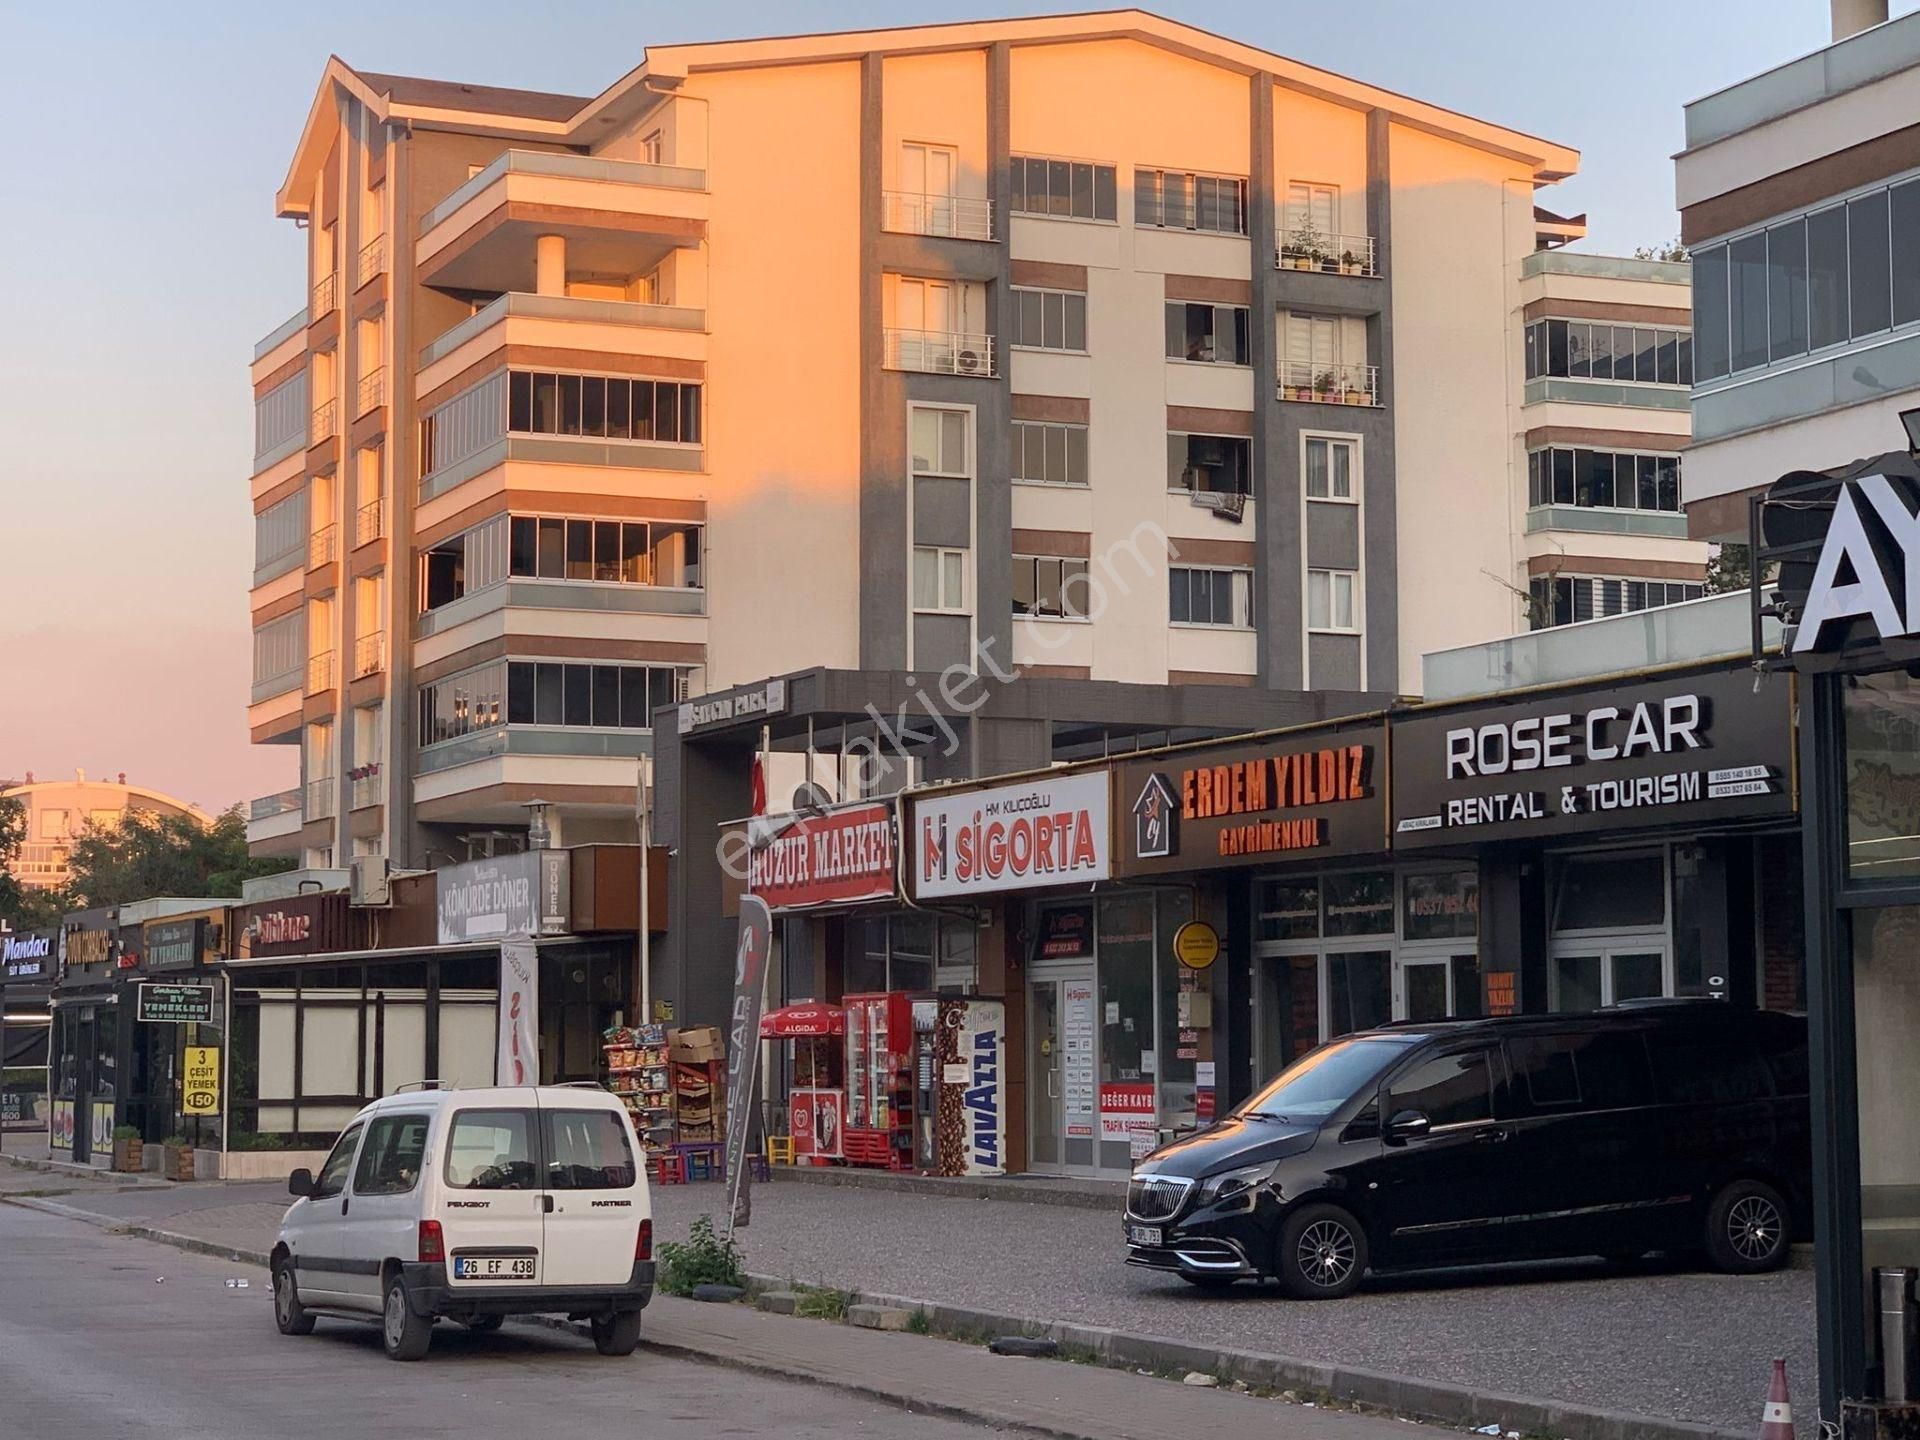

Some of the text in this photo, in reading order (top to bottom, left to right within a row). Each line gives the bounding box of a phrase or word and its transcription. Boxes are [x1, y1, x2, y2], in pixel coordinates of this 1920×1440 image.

[1447, 694, 1700, 779] ROSE CAR
[1183, 744, 1364, 819] ERDEM YILDIZ
[1448, 771, 1700, 827] RENTAL & TOURISM
[985, 793, 1051, 816] HM KILIÇOĞLU
[814, 820, 893, 879] MARKET
[955, 809, 1097, 883] SİGORTA
[1219, 817, 1320, 857] GAYRİMENKUL
[444, 873, 530, 917] KÖMÜRDE DÖNER
[2, 933, 49, 967] Mandacı
[198, 1050, 206, 1065] 3
[187, 1079, 216, 1089] YEMEK
[188, 1094, 212, 1106] 150
[964, 1030, 998, 1168] LAVAZZA
[1101, 1091, 1129, 1107] DEĞER
[447, 1200, 490, 1208] PEUGEOT
[464, 1260, 532, 1273] 26 EF 438
